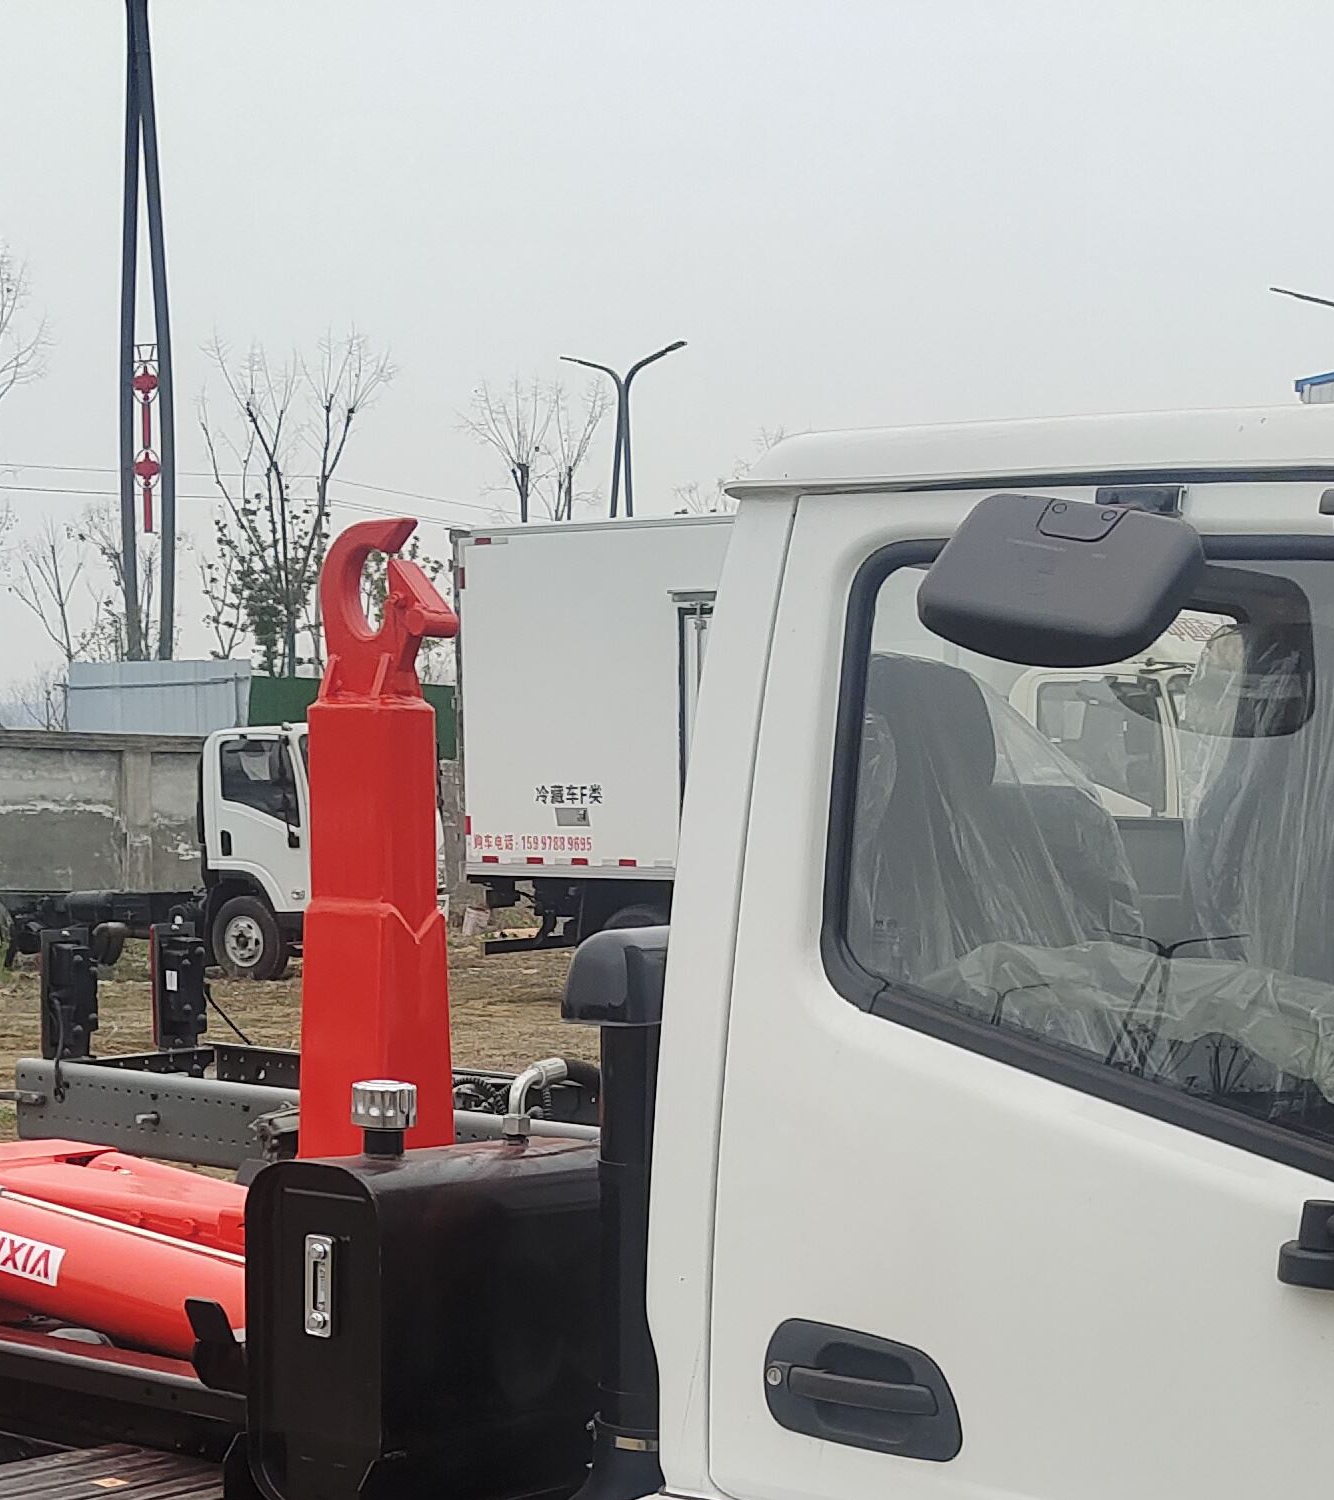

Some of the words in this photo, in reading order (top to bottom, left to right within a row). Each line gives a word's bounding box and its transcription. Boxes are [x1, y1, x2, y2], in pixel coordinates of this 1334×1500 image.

[535, 784, 603, 804] 冷藏车F类
[522, 835, 539, 850] 159
[541, 836, 565, 851] 9788
[568, 837, 592, 852] 9695
